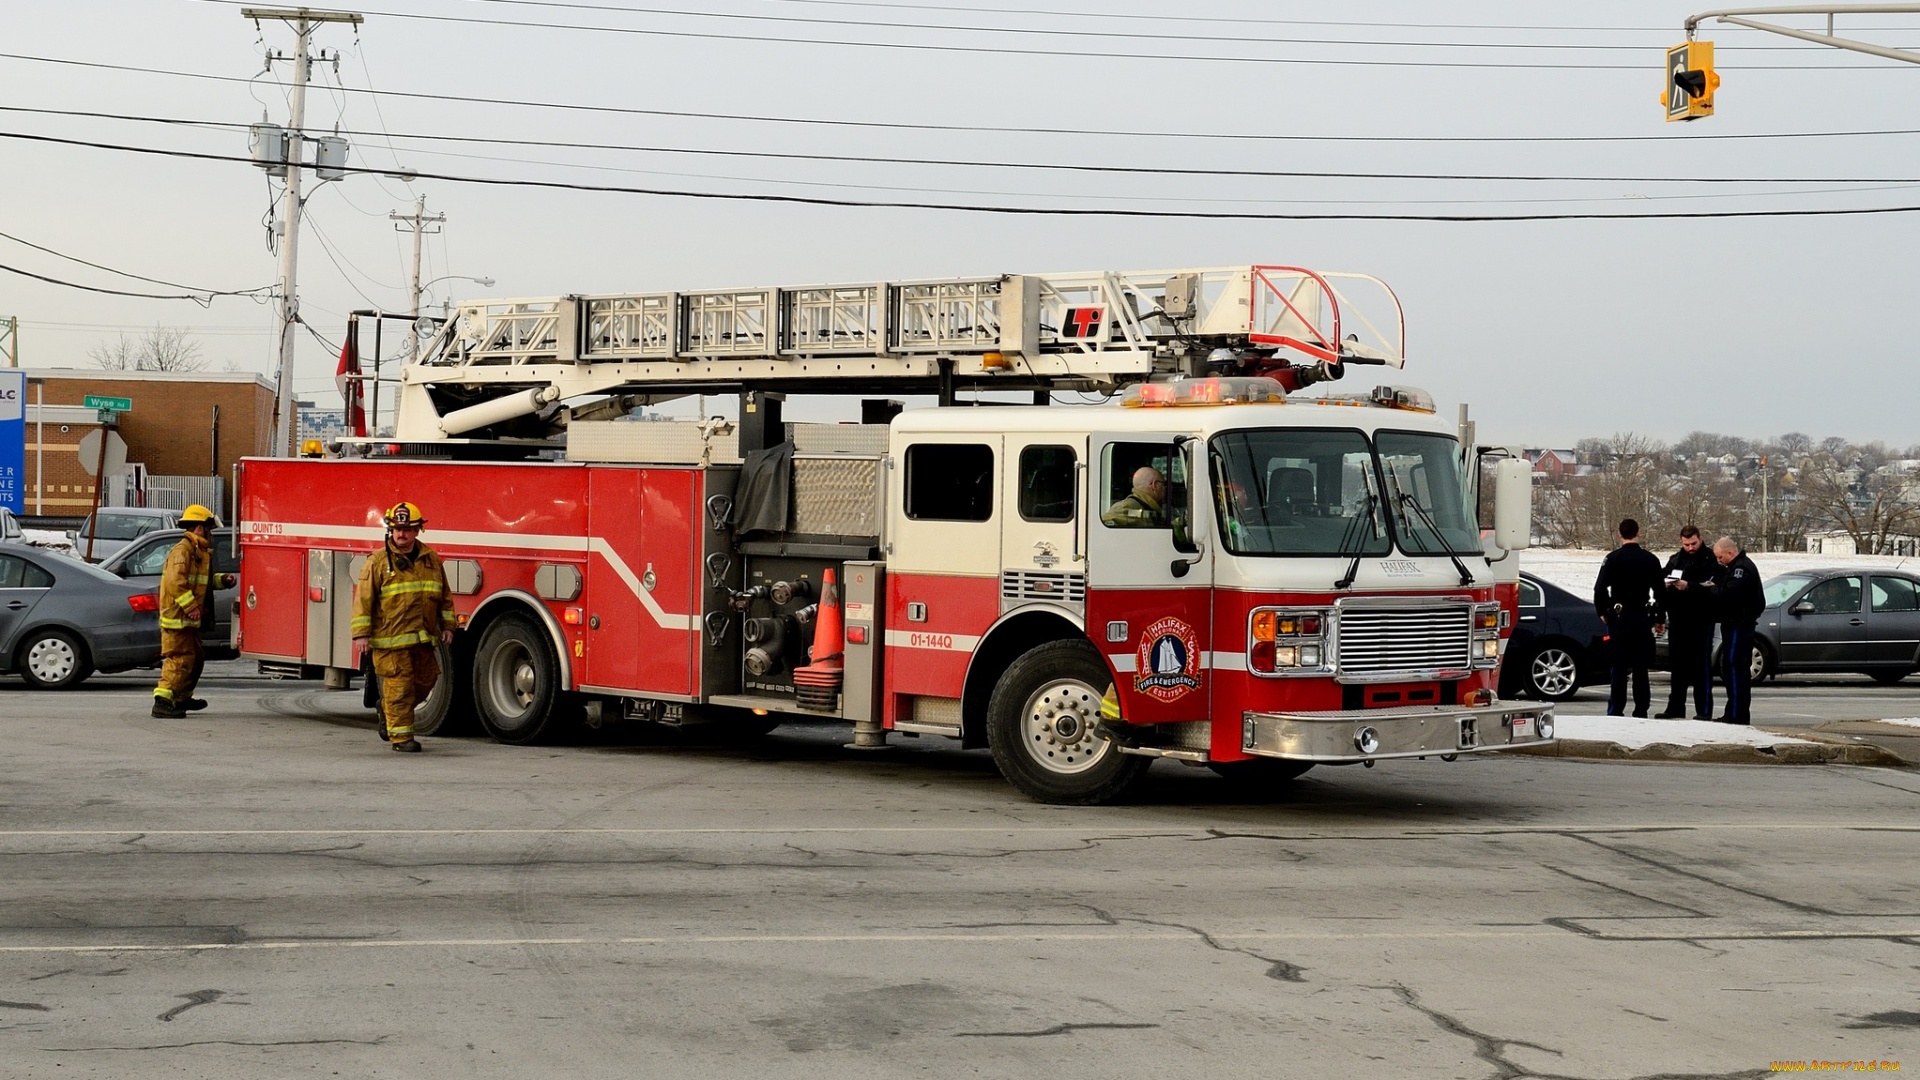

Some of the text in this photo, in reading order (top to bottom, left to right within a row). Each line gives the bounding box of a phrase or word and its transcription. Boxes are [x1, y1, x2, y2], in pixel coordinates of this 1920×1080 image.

[91, 398, 114, 408] Wyse
[252, 522, 283, 534] QUINT 13
[1380, 560, 1421, 573] HALIFAX
[1151, 619, 1187, 633] HALIFAX
[1154, 627, 1182, 638] REGIONAL
[910, 633, 953, 649] 01-144Q
[1140, 677, 1153, 690] FIRE
[1159, 676, 1196, 687] EMERGENCY
